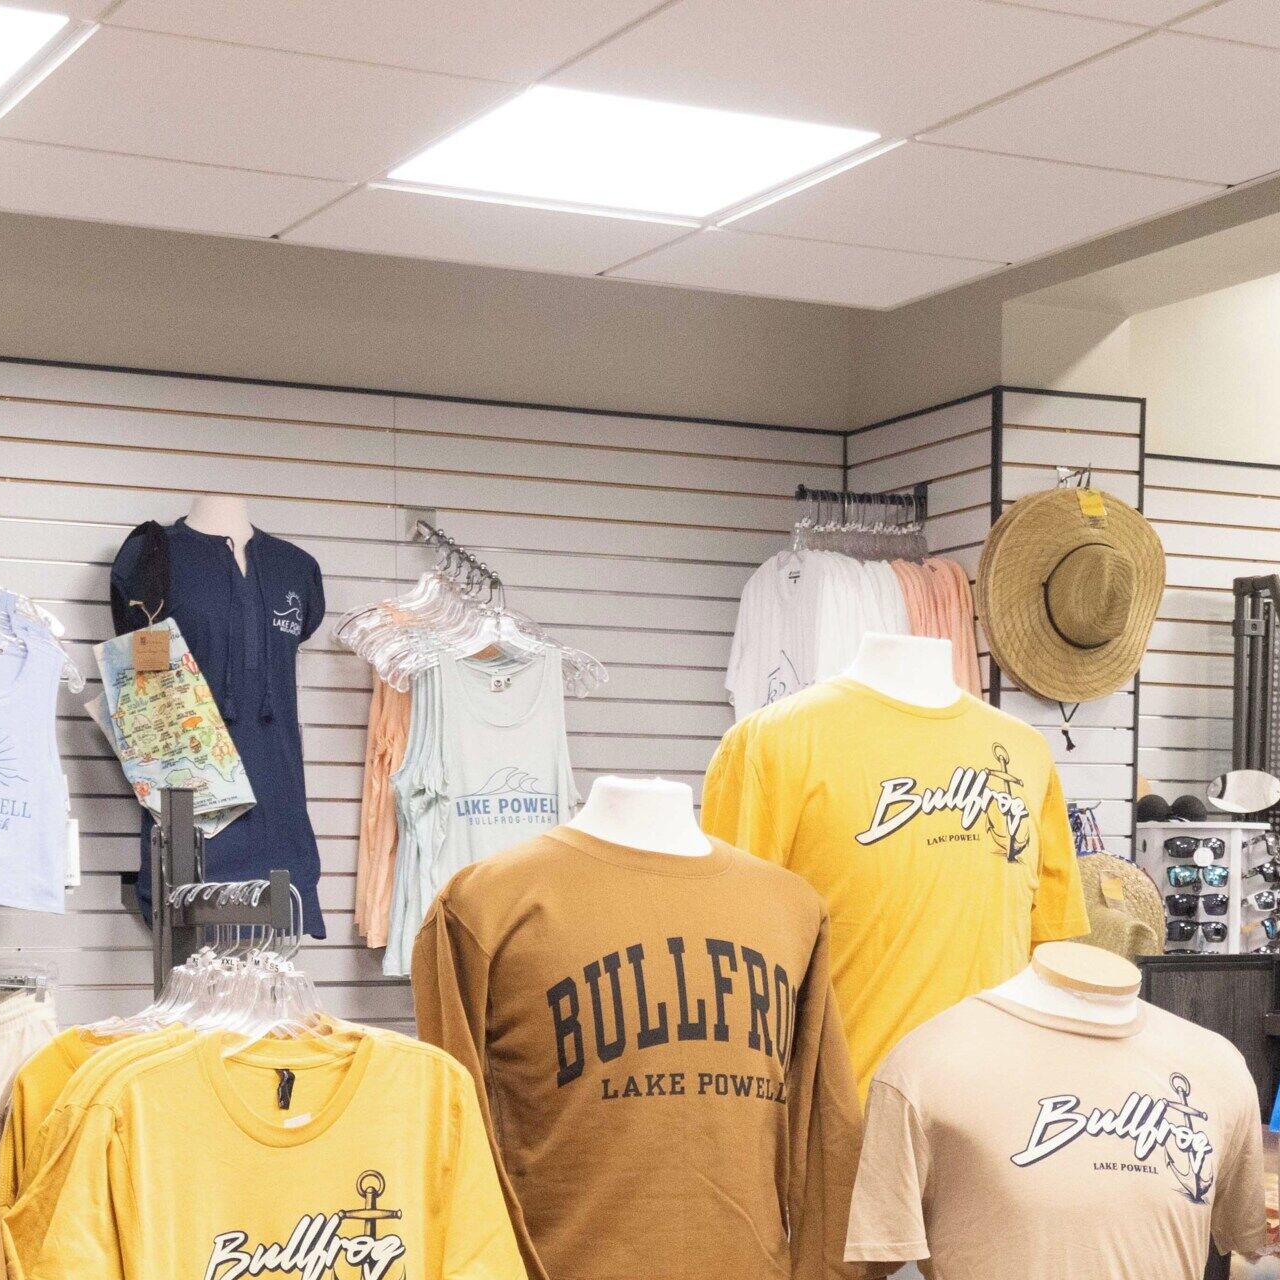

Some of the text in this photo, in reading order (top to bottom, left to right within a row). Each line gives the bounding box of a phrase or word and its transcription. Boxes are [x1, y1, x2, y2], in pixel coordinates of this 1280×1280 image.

[456, 798, 559, 817] LAKE POWEL
[854, 766, 1030, 846] Bullfrog
[546, 936, 798, 1089] BULLFRO
[601, 1072, 787, 1105] LAKE POWELL
[1010, 1091, 1214, 1176] Bullfrog
[1093, 1161, 1160, 1175] LAKE POWELL
